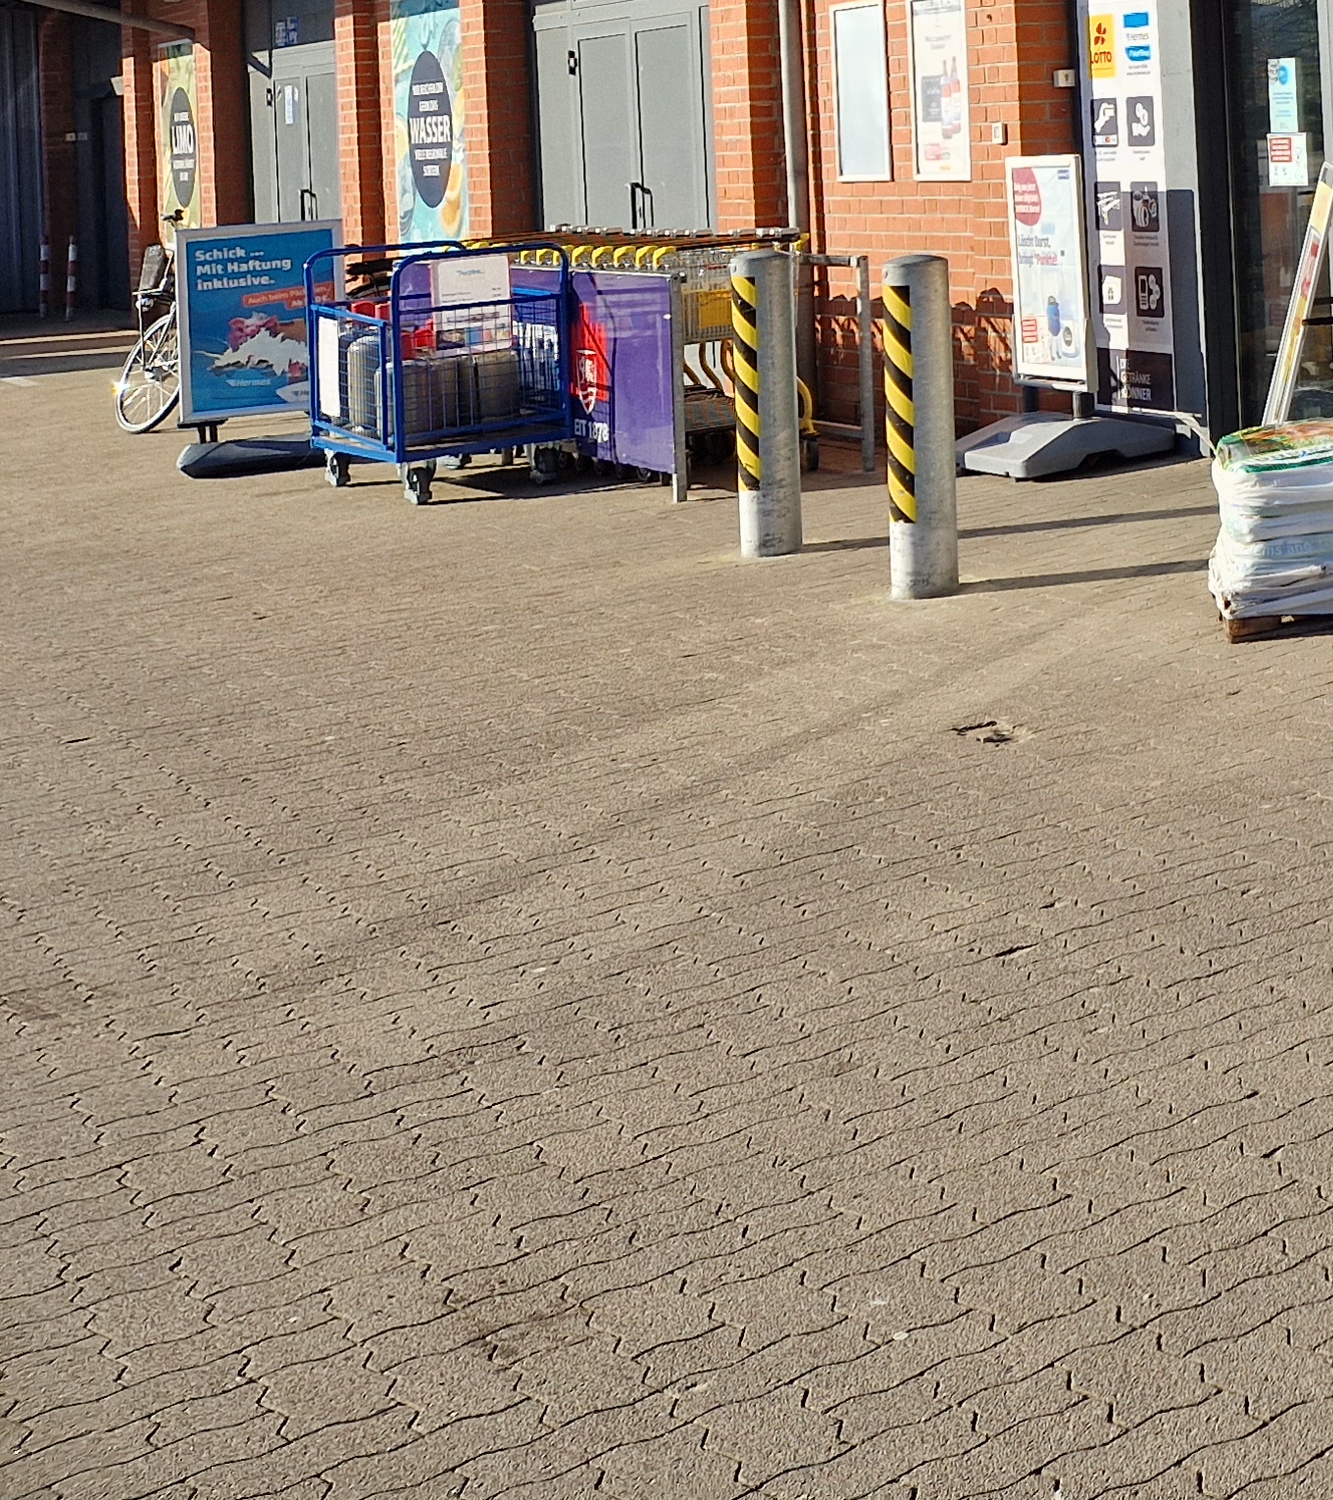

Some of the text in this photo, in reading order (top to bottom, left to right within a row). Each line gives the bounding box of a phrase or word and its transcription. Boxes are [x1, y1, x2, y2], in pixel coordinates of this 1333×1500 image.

[1090, 51, 1112, 64] LOTTO
[409, 115, 451, 144] WASSER
[171, 124, 194, 154] LIMO
[195, 247, 246, 261] Schick
[196, 259, 291, 276] Mit Haftung
[196, 274, 275, 291] inklusive.
[248, 295, 268, 305] Auch
[269, 292, 288, 302] beim
